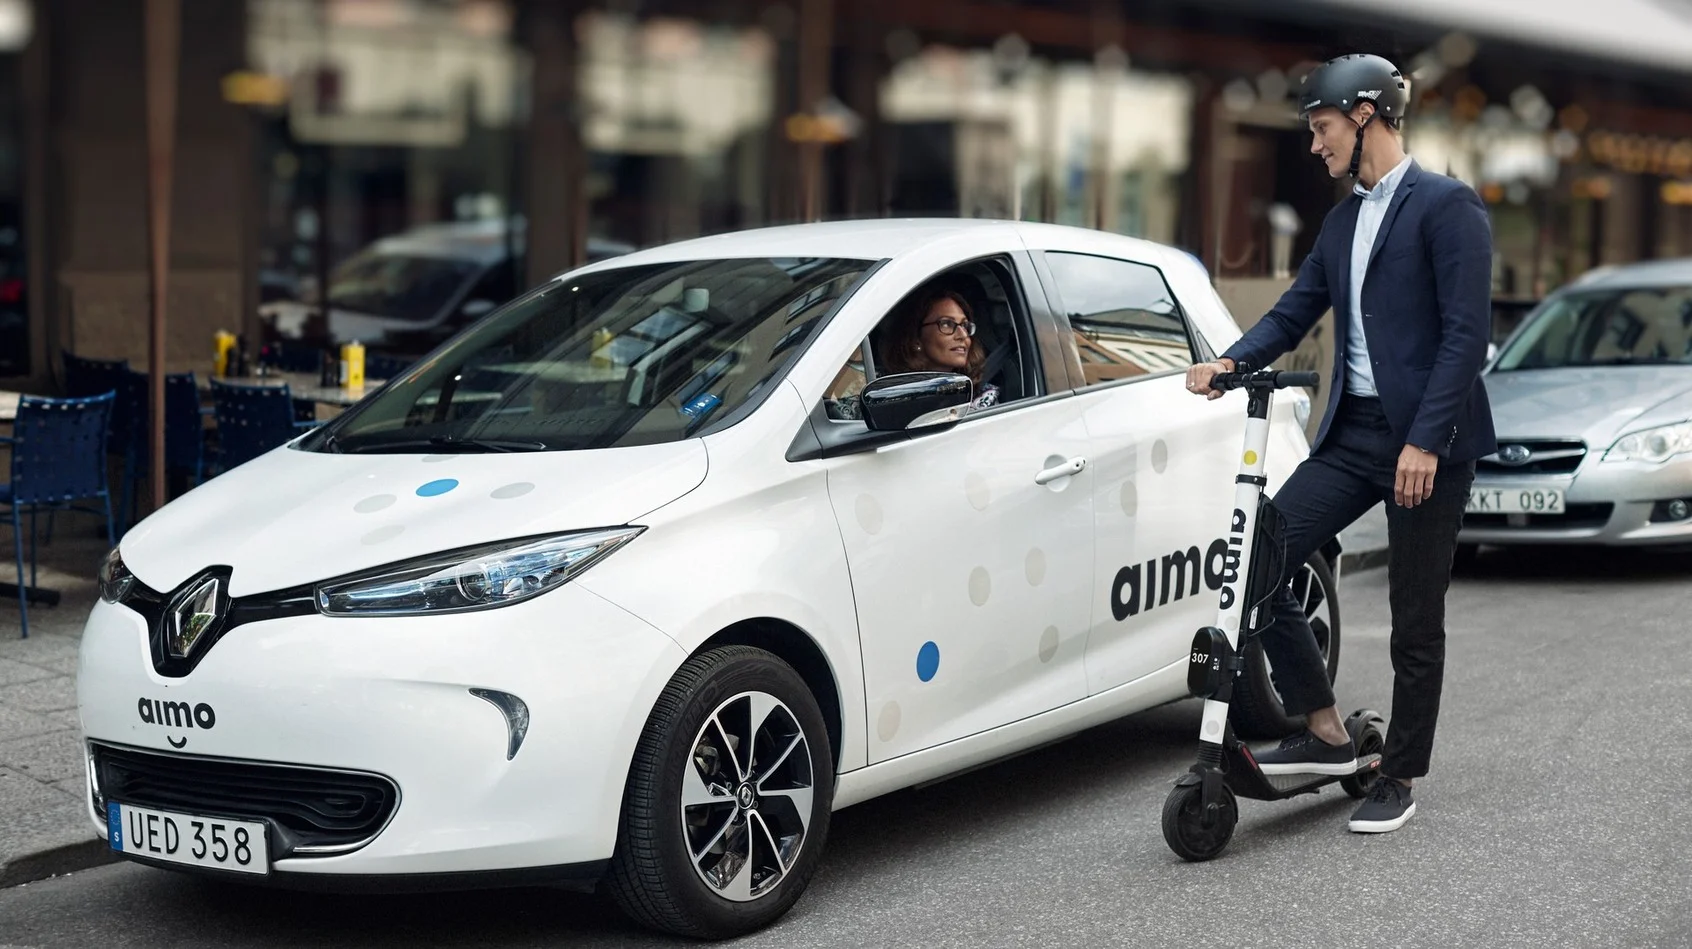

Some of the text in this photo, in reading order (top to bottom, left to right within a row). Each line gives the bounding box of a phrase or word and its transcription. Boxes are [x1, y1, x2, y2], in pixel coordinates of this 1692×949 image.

[1519, 491, 1559, 511] 092
[1219, 508, 1247, 610] aimo
[1111, 538, 1229, 622] aimo
[1191, 652, 1209, 664] 307
[138, 697, 216, 730] aimo
[114, 831, 120, 842] S
[129, 811, 252, 866] UED 358
